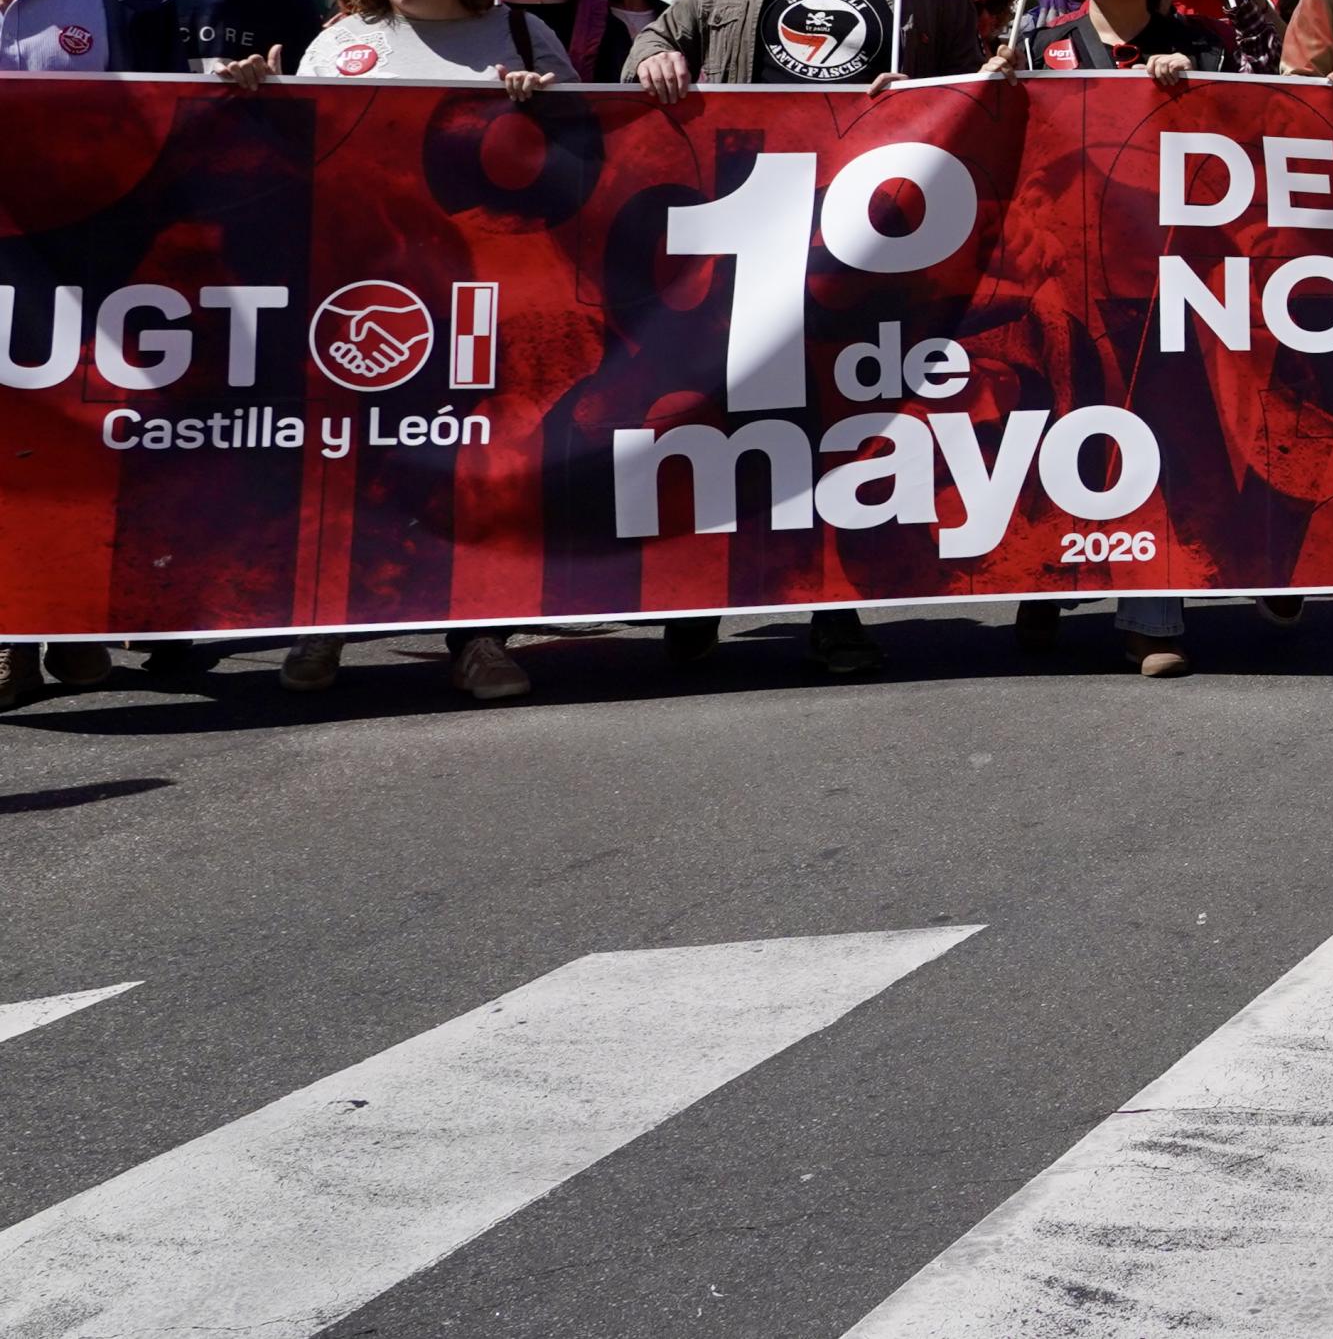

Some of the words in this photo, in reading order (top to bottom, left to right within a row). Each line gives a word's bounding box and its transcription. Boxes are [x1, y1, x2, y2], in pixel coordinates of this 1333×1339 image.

[341, 48, 373, 63] UGT
[769, 44, 869, 78] ANTI-FASCIST
[0, 283, 289, 391] UGT
[833, 320, 970, 402] de
[102, 406, 305, 450] Castilla
[321, 416, 351, 459] y
[369, 404, 490, 446] León
[612, 404, 1161, 559] mayo
[1059, 530, 1156, 563] 2026
